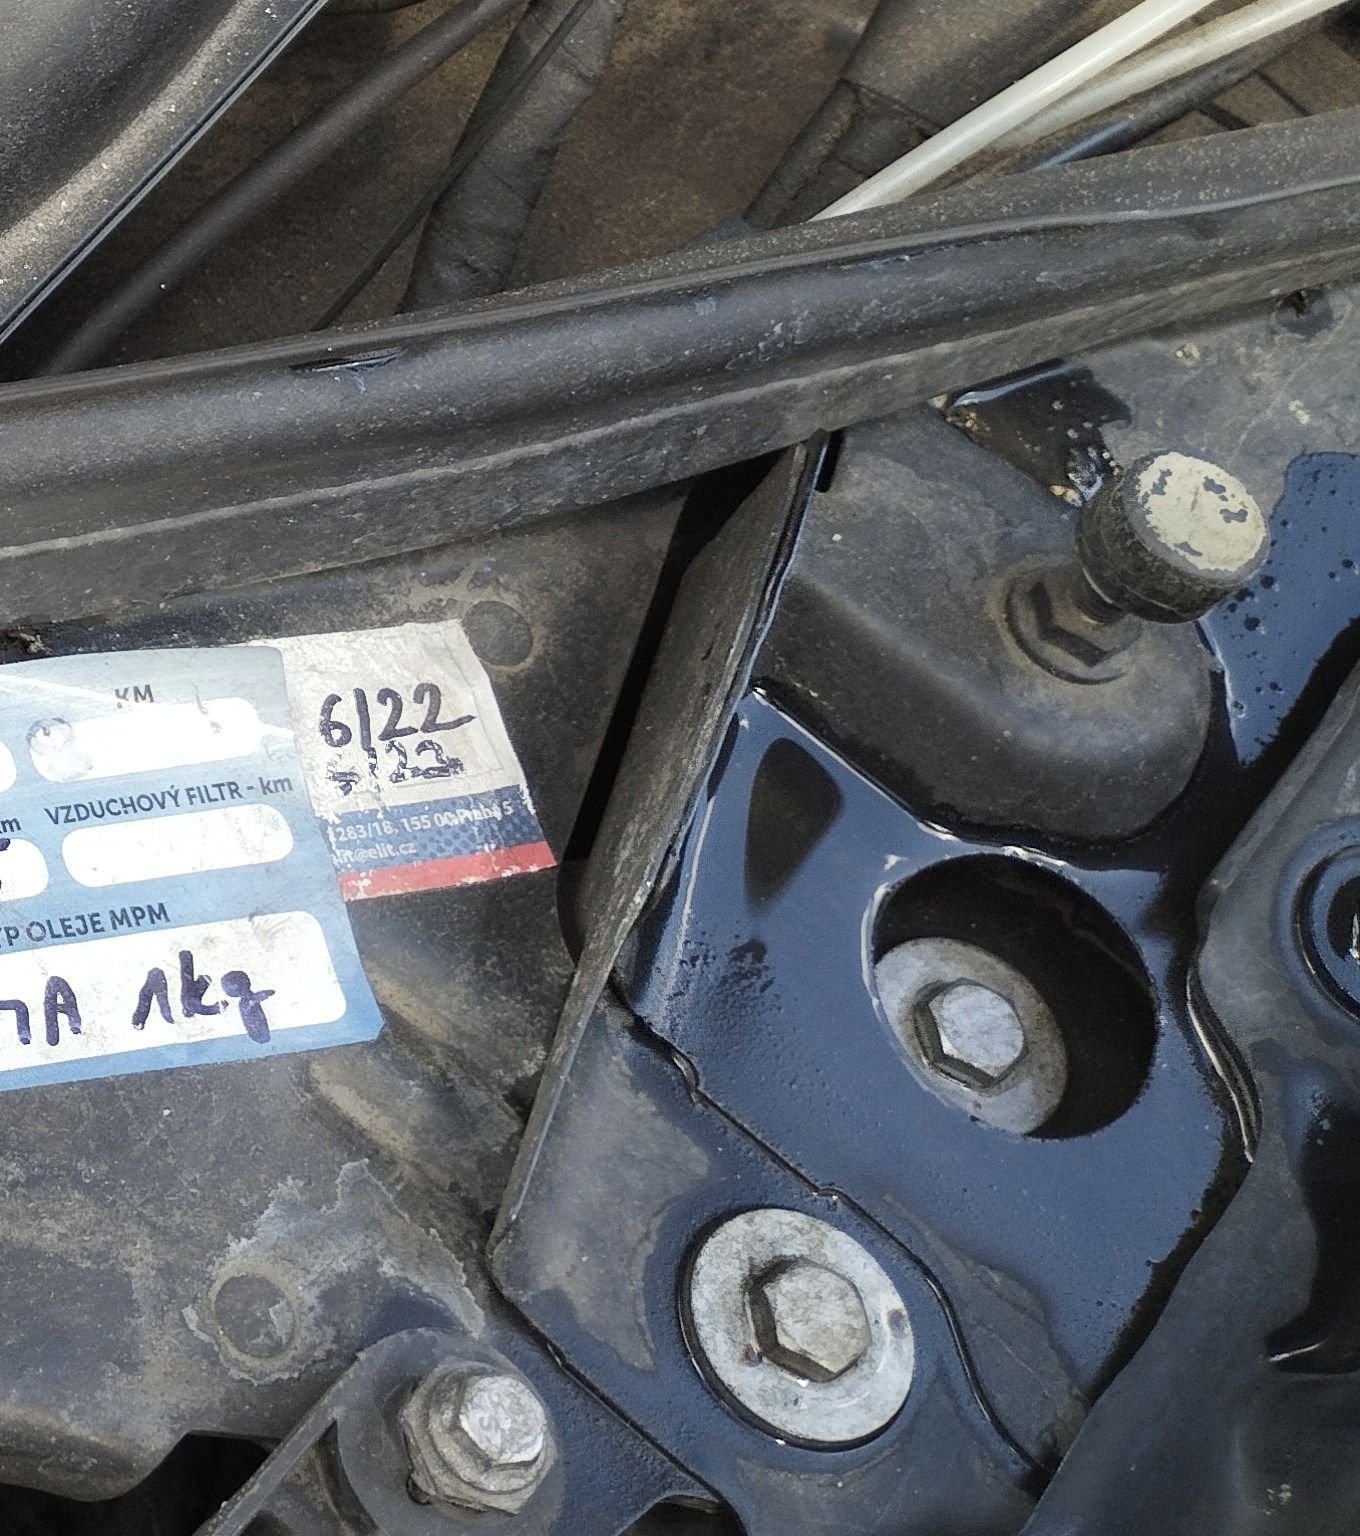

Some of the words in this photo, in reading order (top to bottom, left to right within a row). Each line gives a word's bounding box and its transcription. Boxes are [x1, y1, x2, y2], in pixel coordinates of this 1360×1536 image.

[317, 681, 478, 751] 6/22
[43, 783, 181, 825] VZDUCHOVÝ
[185, 780, 244, 806] FILTR
[258, 775, 295, 797] km
[400, 814, 431, 832] 155
[24, 911, 108, 945] OLEJE
[110, 900, 171, 936] MPM
